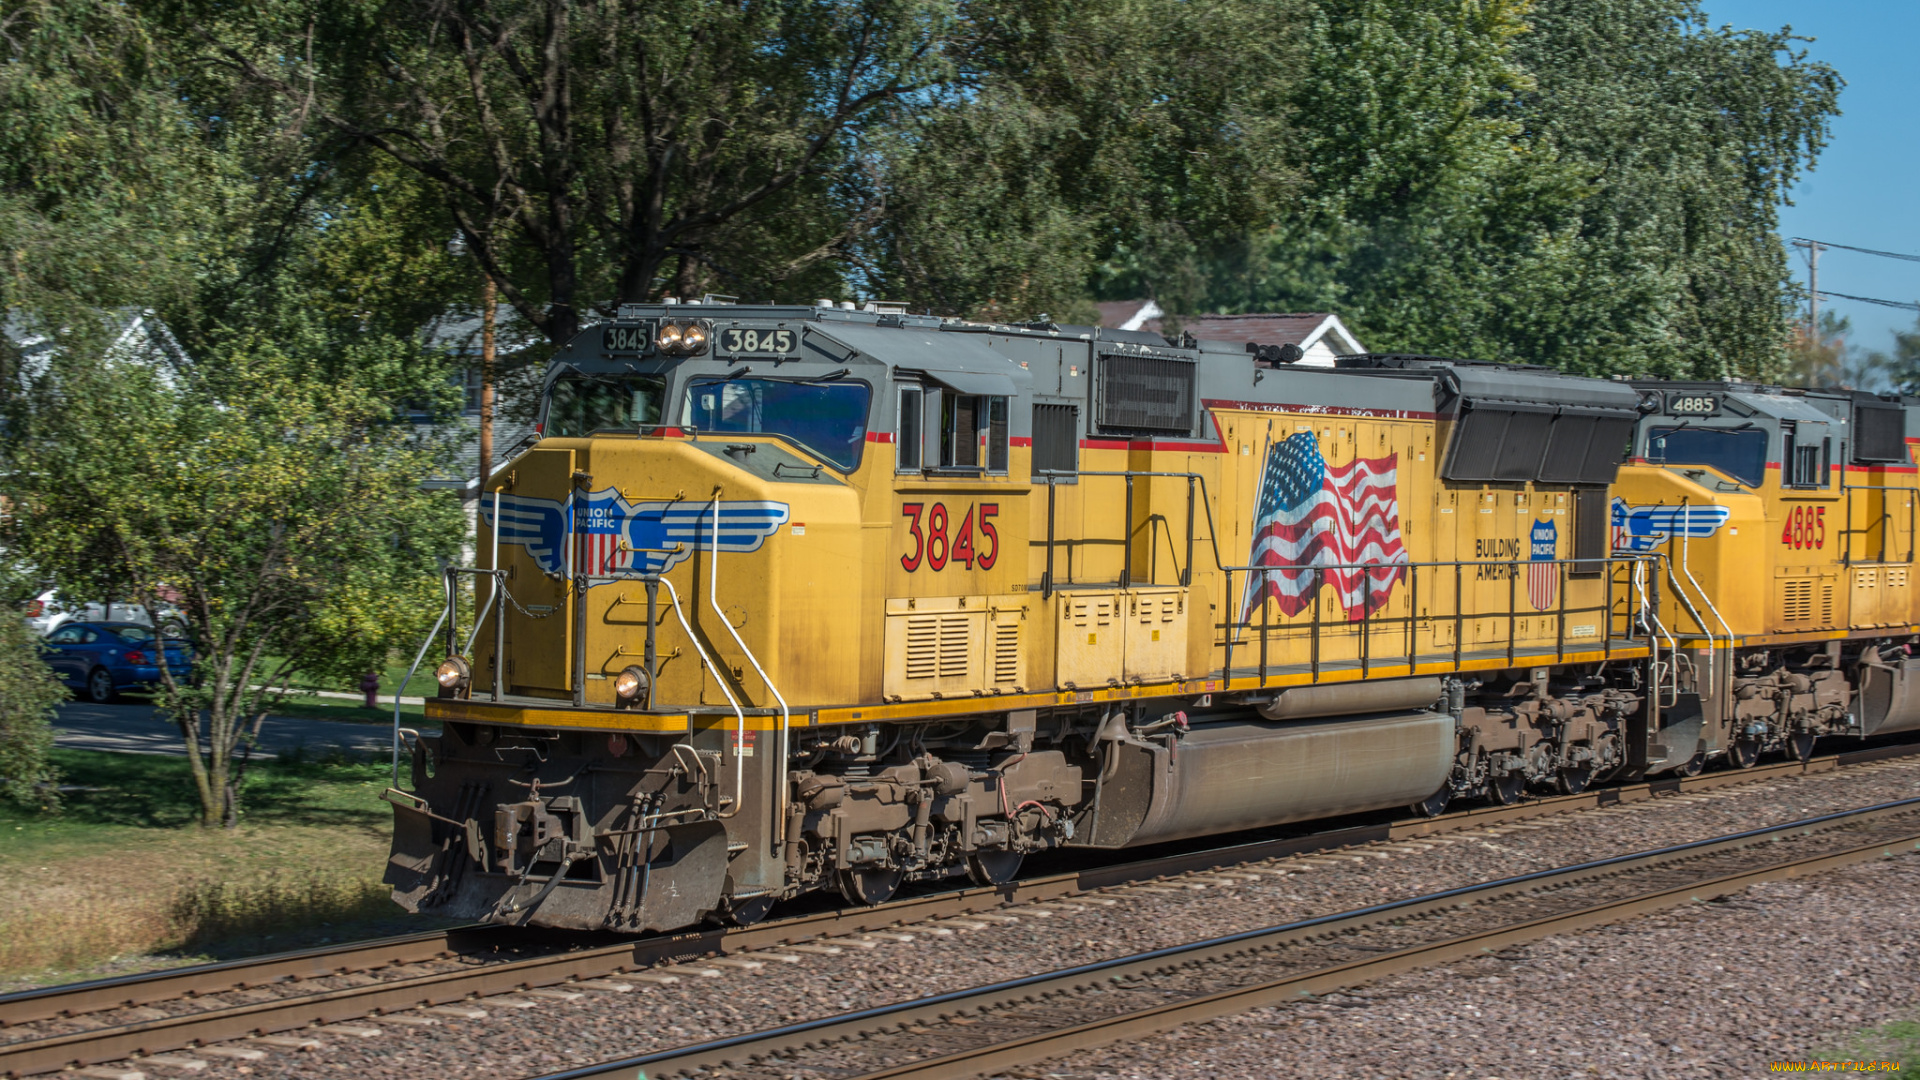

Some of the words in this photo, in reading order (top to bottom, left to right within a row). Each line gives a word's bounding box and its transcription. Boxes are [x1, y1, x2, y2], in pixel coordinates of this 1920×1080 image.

[607, 328, 647, 350] 3845
[727, 330, 790, 352] 3845
[1672, 397, 1714, 412] 4885
[577, 508, 613, 518] UNION
[576, 518, 615, 529] PACIFIC
[1781, 505, 1825, 550] 4885
[900, 501, 999, 573] 3845
[1533, 529, 1555, 540] UNION
[1476, 538, 1520, 558] BUILDING
[1532, 543, 1555, 555] PACIFIC
